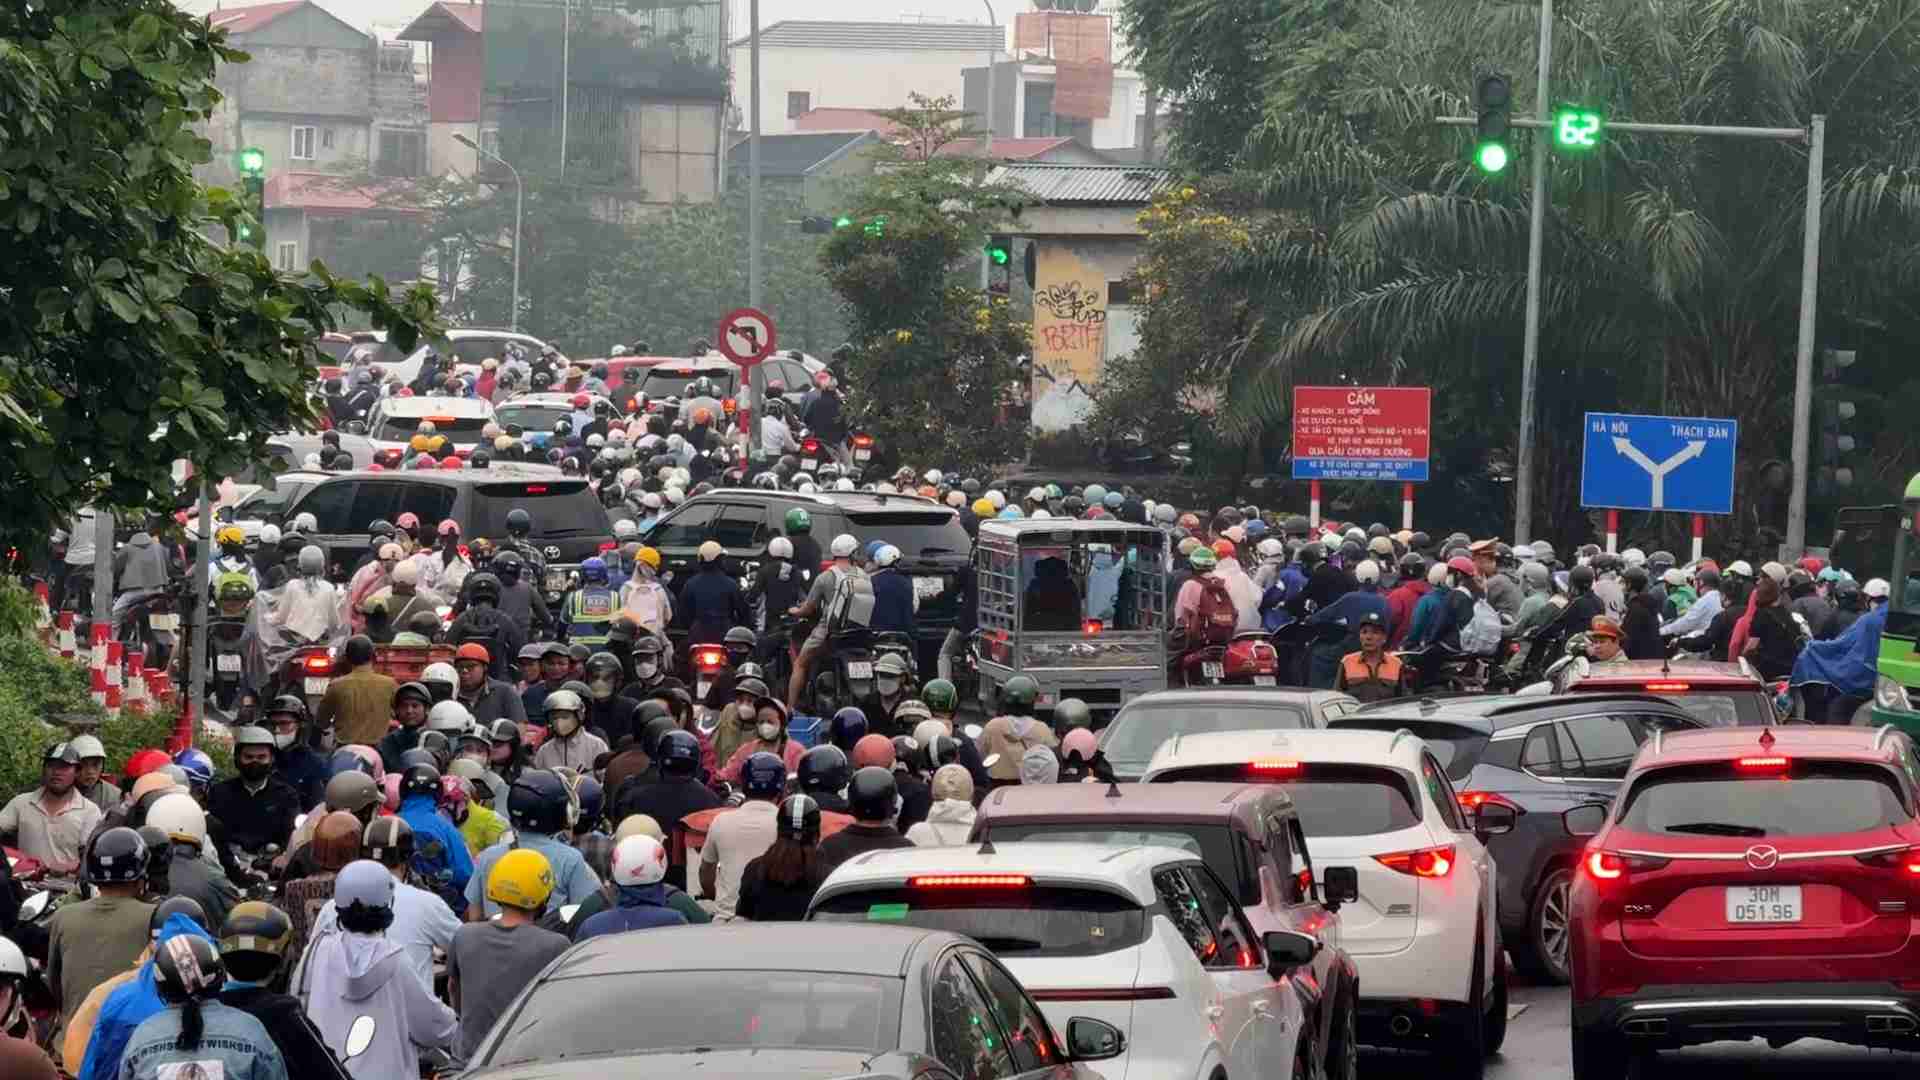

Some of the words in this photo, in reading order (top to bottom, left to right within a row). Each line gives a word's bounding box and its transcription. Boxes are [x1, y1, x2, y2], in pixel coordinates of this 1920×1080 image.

[1559, 113, 1599, 145] 62
[1347, 387, 1376, 406] CẤM
[1592, 418, 1607, 433] HÀ
[1611, 419, 1629, 436] NỘI
[1671, 424, 1704, 440] THẠCH
[1707, 423, 1729, 439] BÀN
[1308, 447, 1325, 456] QUA
[1736, 904, 1793, 920] 051.96
